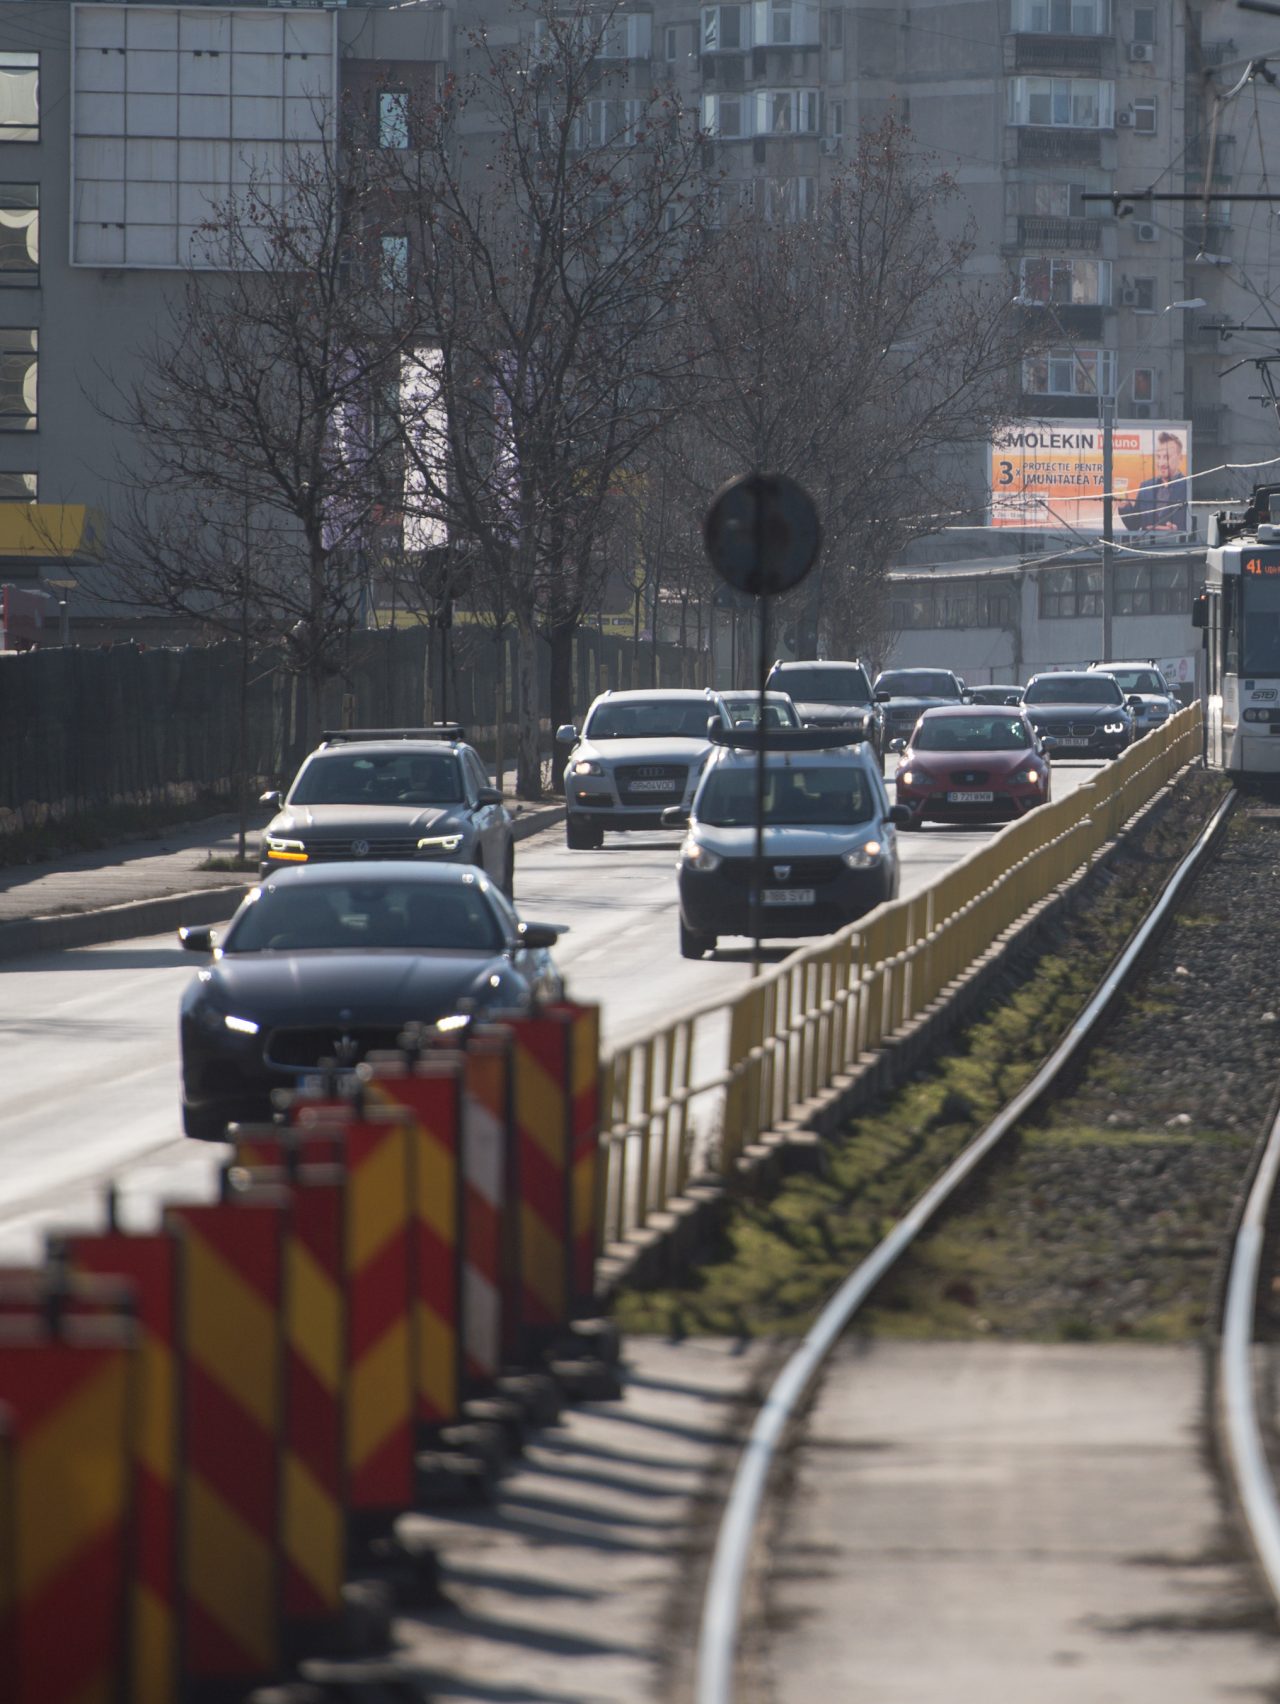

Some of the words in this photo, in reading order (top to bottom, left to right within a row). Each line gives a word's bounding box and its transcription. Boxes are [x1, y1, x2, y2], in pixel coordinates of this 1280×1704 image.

[1008, 432, 1094, 449] MOLEKIN
[999, 460, 1014, 485] 3
[1074, 463, 1104, 472] PENTR
[1023, 474, 1090, 485] IMUNITATEA
[1246, 558, 1262, 575] 41
